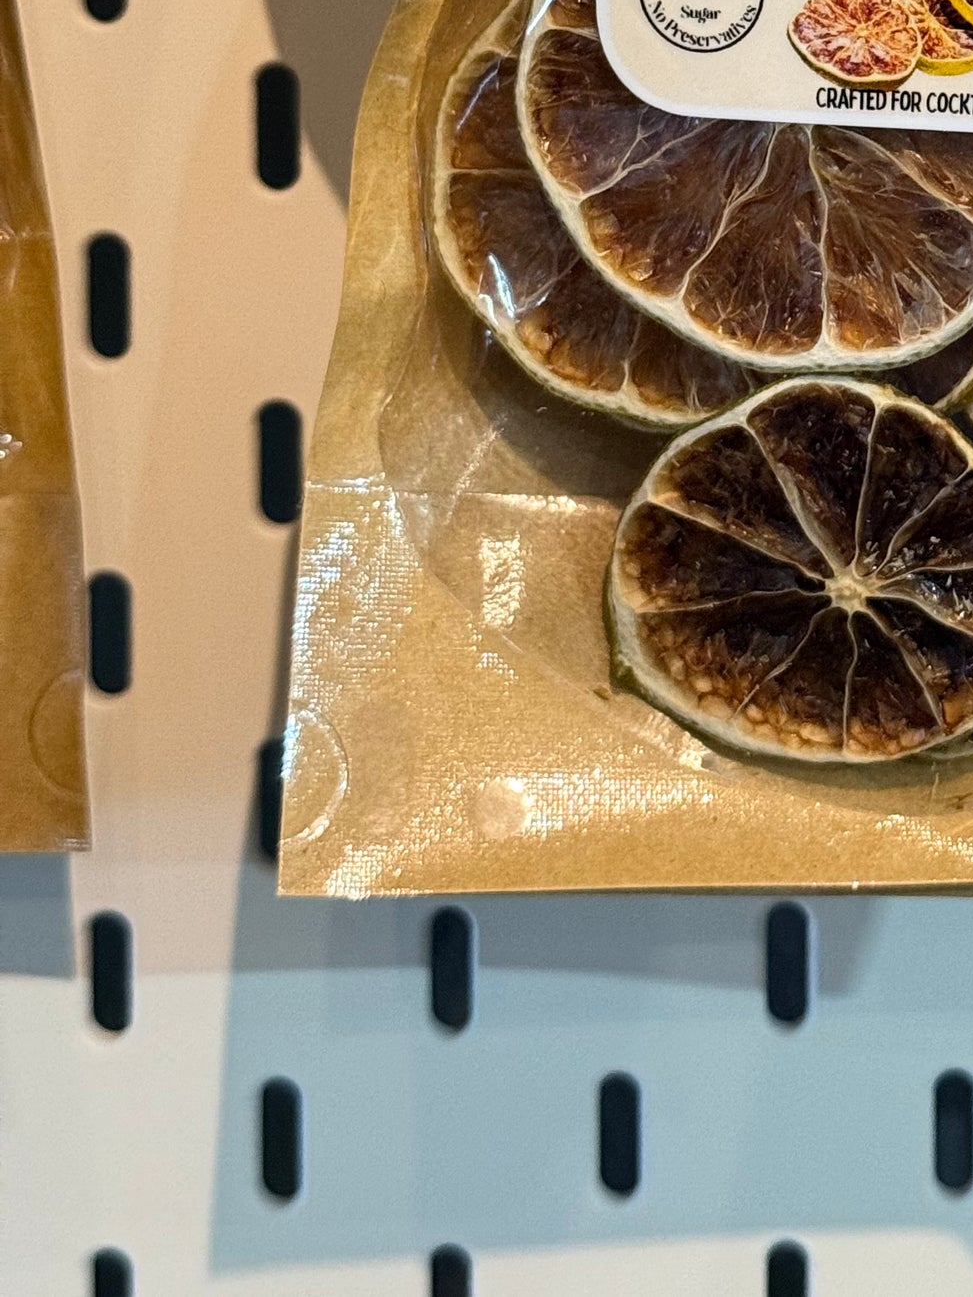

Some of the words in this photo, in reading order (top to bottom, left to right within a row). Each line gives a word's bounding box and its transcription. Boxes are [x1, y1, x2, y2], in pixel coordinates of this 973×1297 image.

[648, 0, 666, 24] No
[664, 5, 758, 47] Preservatives
[680, 5, 722, 24] Sugar
[816, 88, 887, 112] CRAFTED
[890, 91, 922, 114] FOR
